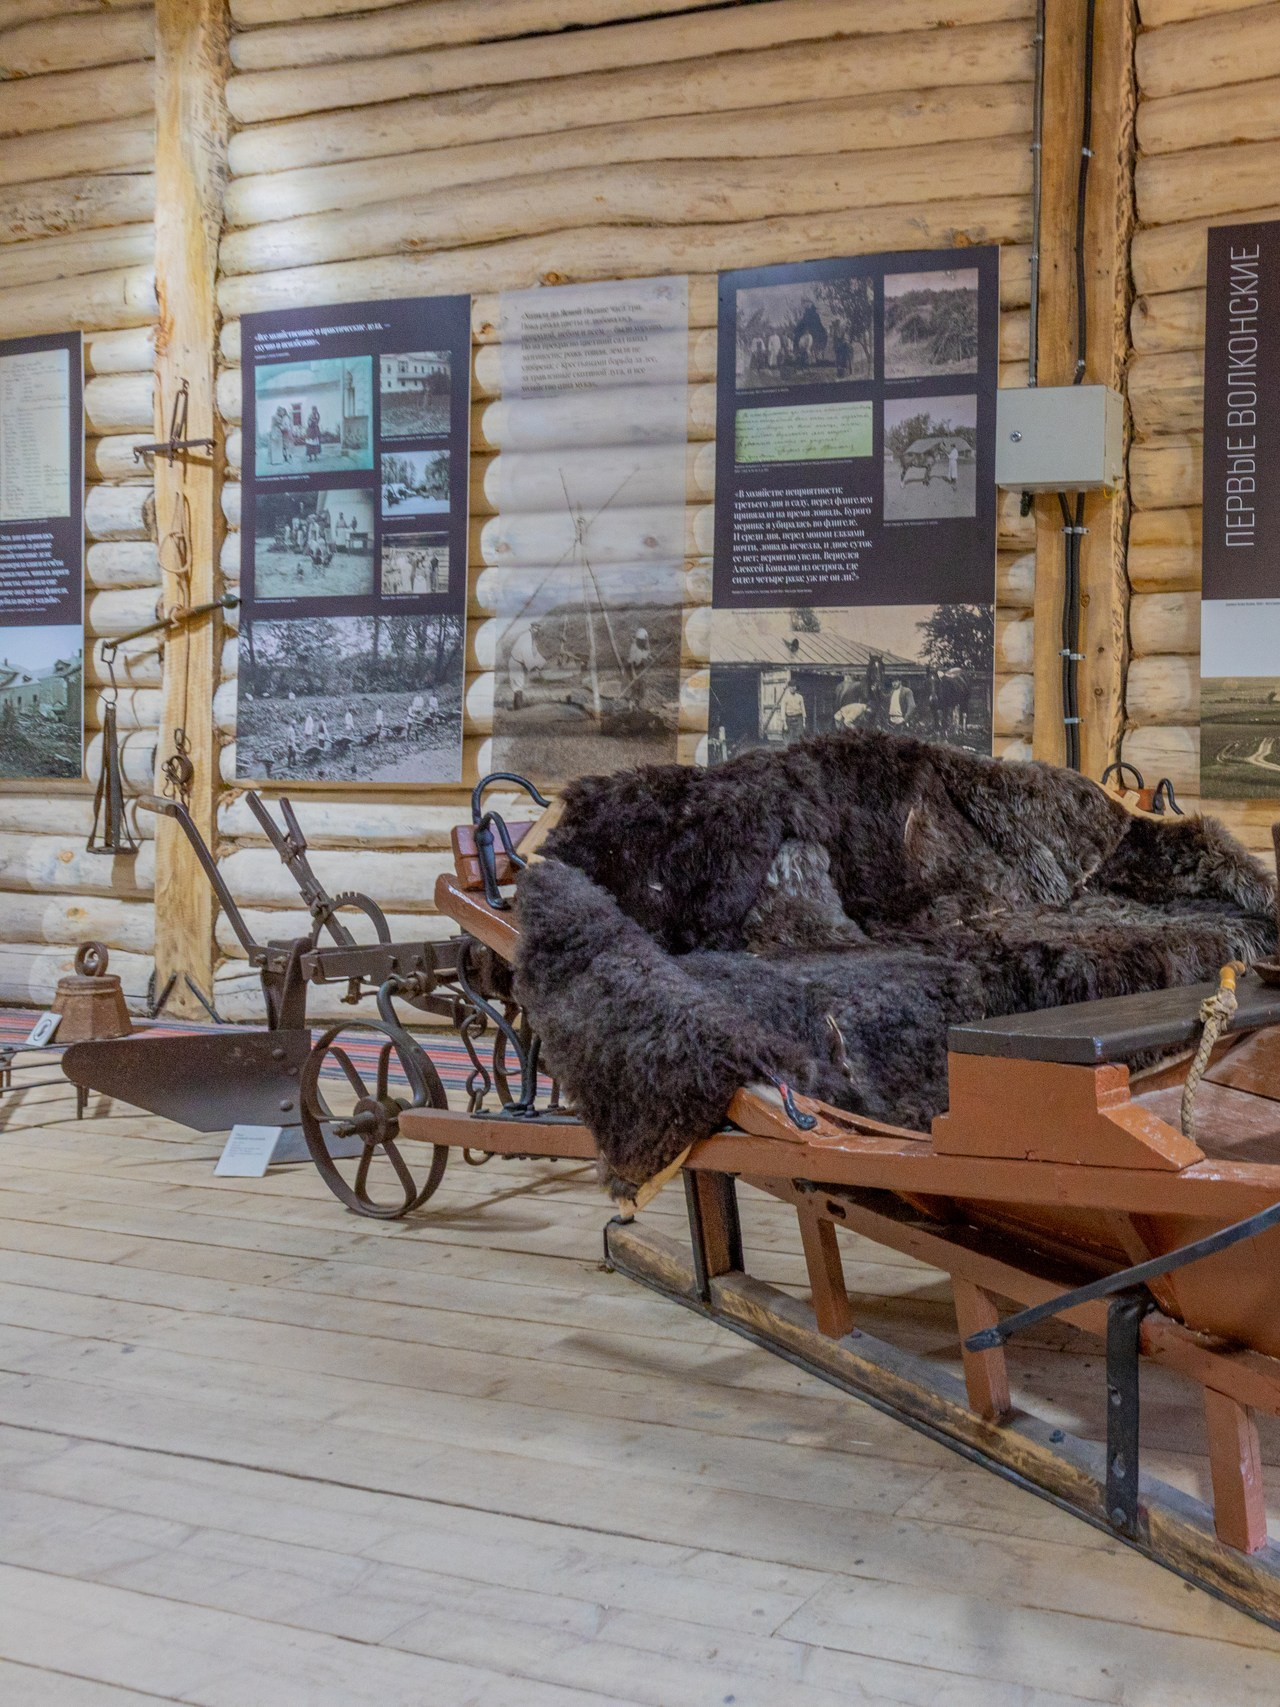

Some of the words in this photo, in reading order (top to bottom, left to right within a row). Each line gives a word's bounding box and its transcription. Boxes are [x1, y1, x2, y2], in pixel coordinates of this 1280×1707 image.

[1227, 244, 1260, 427] ВОЛКОНСКИЕ
[735, 489, 745, 498] «В
[746, 488, 784, 498] хозяйстве
[1226, 435, 1256, 546] ПЕРВЫЕ
[734, 501, 768, 510] третьего
[770, 500, 784, 508] дня
[790, 499, 810, 508] саду,
[810, 498, 834, 507] перед
[834, 496, 873, 506] флигелем
[734, 512, 775, 522] привязали
[776, 511, 786, 519] на
[786, 510, 810, 520] время
[844, 506, 872, 517] Бурого
[766, 522, 771, 530] я
[772, 520, 812, 530] убиралась
[813, 520, 822, 528] во
[734, 532, 740, 541] И
[741, 532, 764, 542] среди
[764, 532, 780, 540] дня,
[782, 531, 805, 541] перед
[806, 530, 832, 538] моими
[834, 530, 864, 538] глазами
[733, 544, 758, 552] почти,
[790, 542, 822, 550] исчезла,
[830, 541, 848, 550] двое
[850, 540, 873, 550] суток
[760, 554, 796, 564] вероятно
[824, 552, 860, 561] Вернулся
[732, 564, 764, 574] Алексей
[766, 564, 800, 573] Копылов
[801, 564, 811, 572] из
[812, 563, 845, 572] острога,
[846, 562, 858, 570] где
[732, 576, 754, 584] сидел
[756, 576, 784, 585] четыре
[806, 575, 818, 584] уж
[818, 574, 829, 582] не
